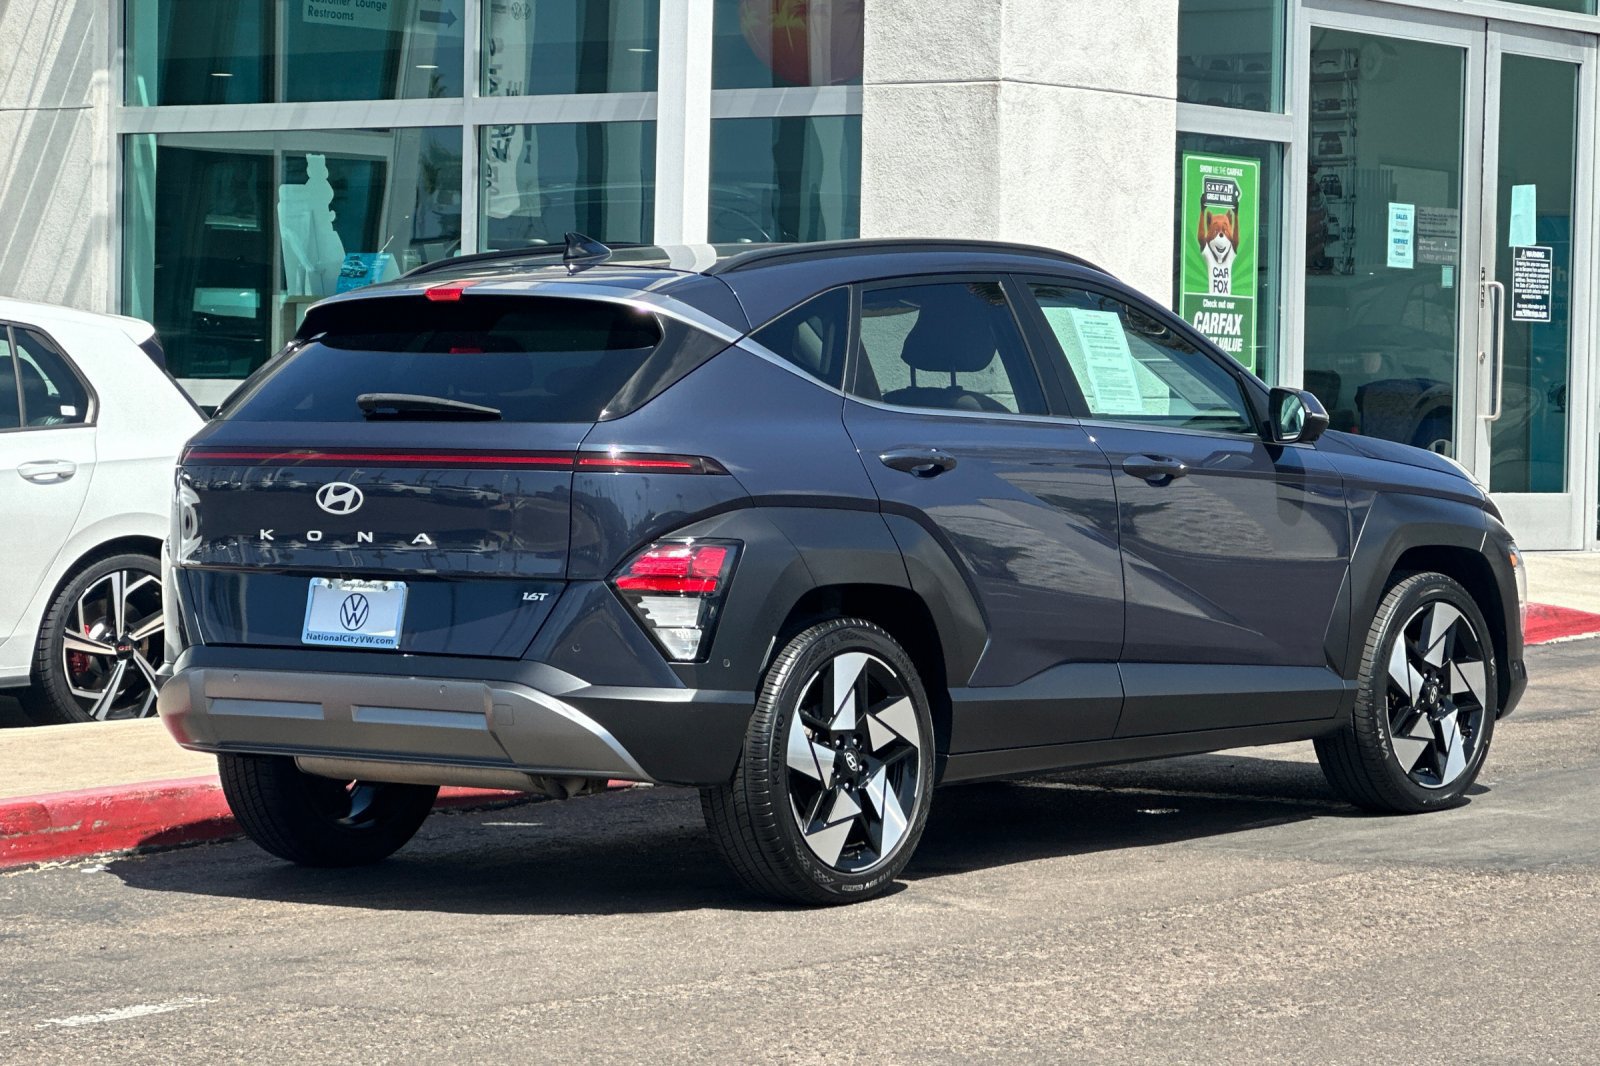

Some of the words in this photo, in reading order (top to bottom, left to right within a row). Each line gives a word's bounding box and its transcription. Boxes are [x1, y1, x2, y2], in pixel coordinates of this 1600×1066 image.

[308, 5, 354, 20] Restrooms
[1212, 267, 1229, 278] CAR
[1213, 280, 1229, 294] FOX
[1202, 299, 1217, 308] Check
[1218, 300, 1226, 308] out
[1193, 311, 1243, 335] CARFAX
[1220, 337, 1243, 352] VALUE
[259, 529, 432, 545] KONA
[306, 632, 394, 645] NationalCityVW.com
